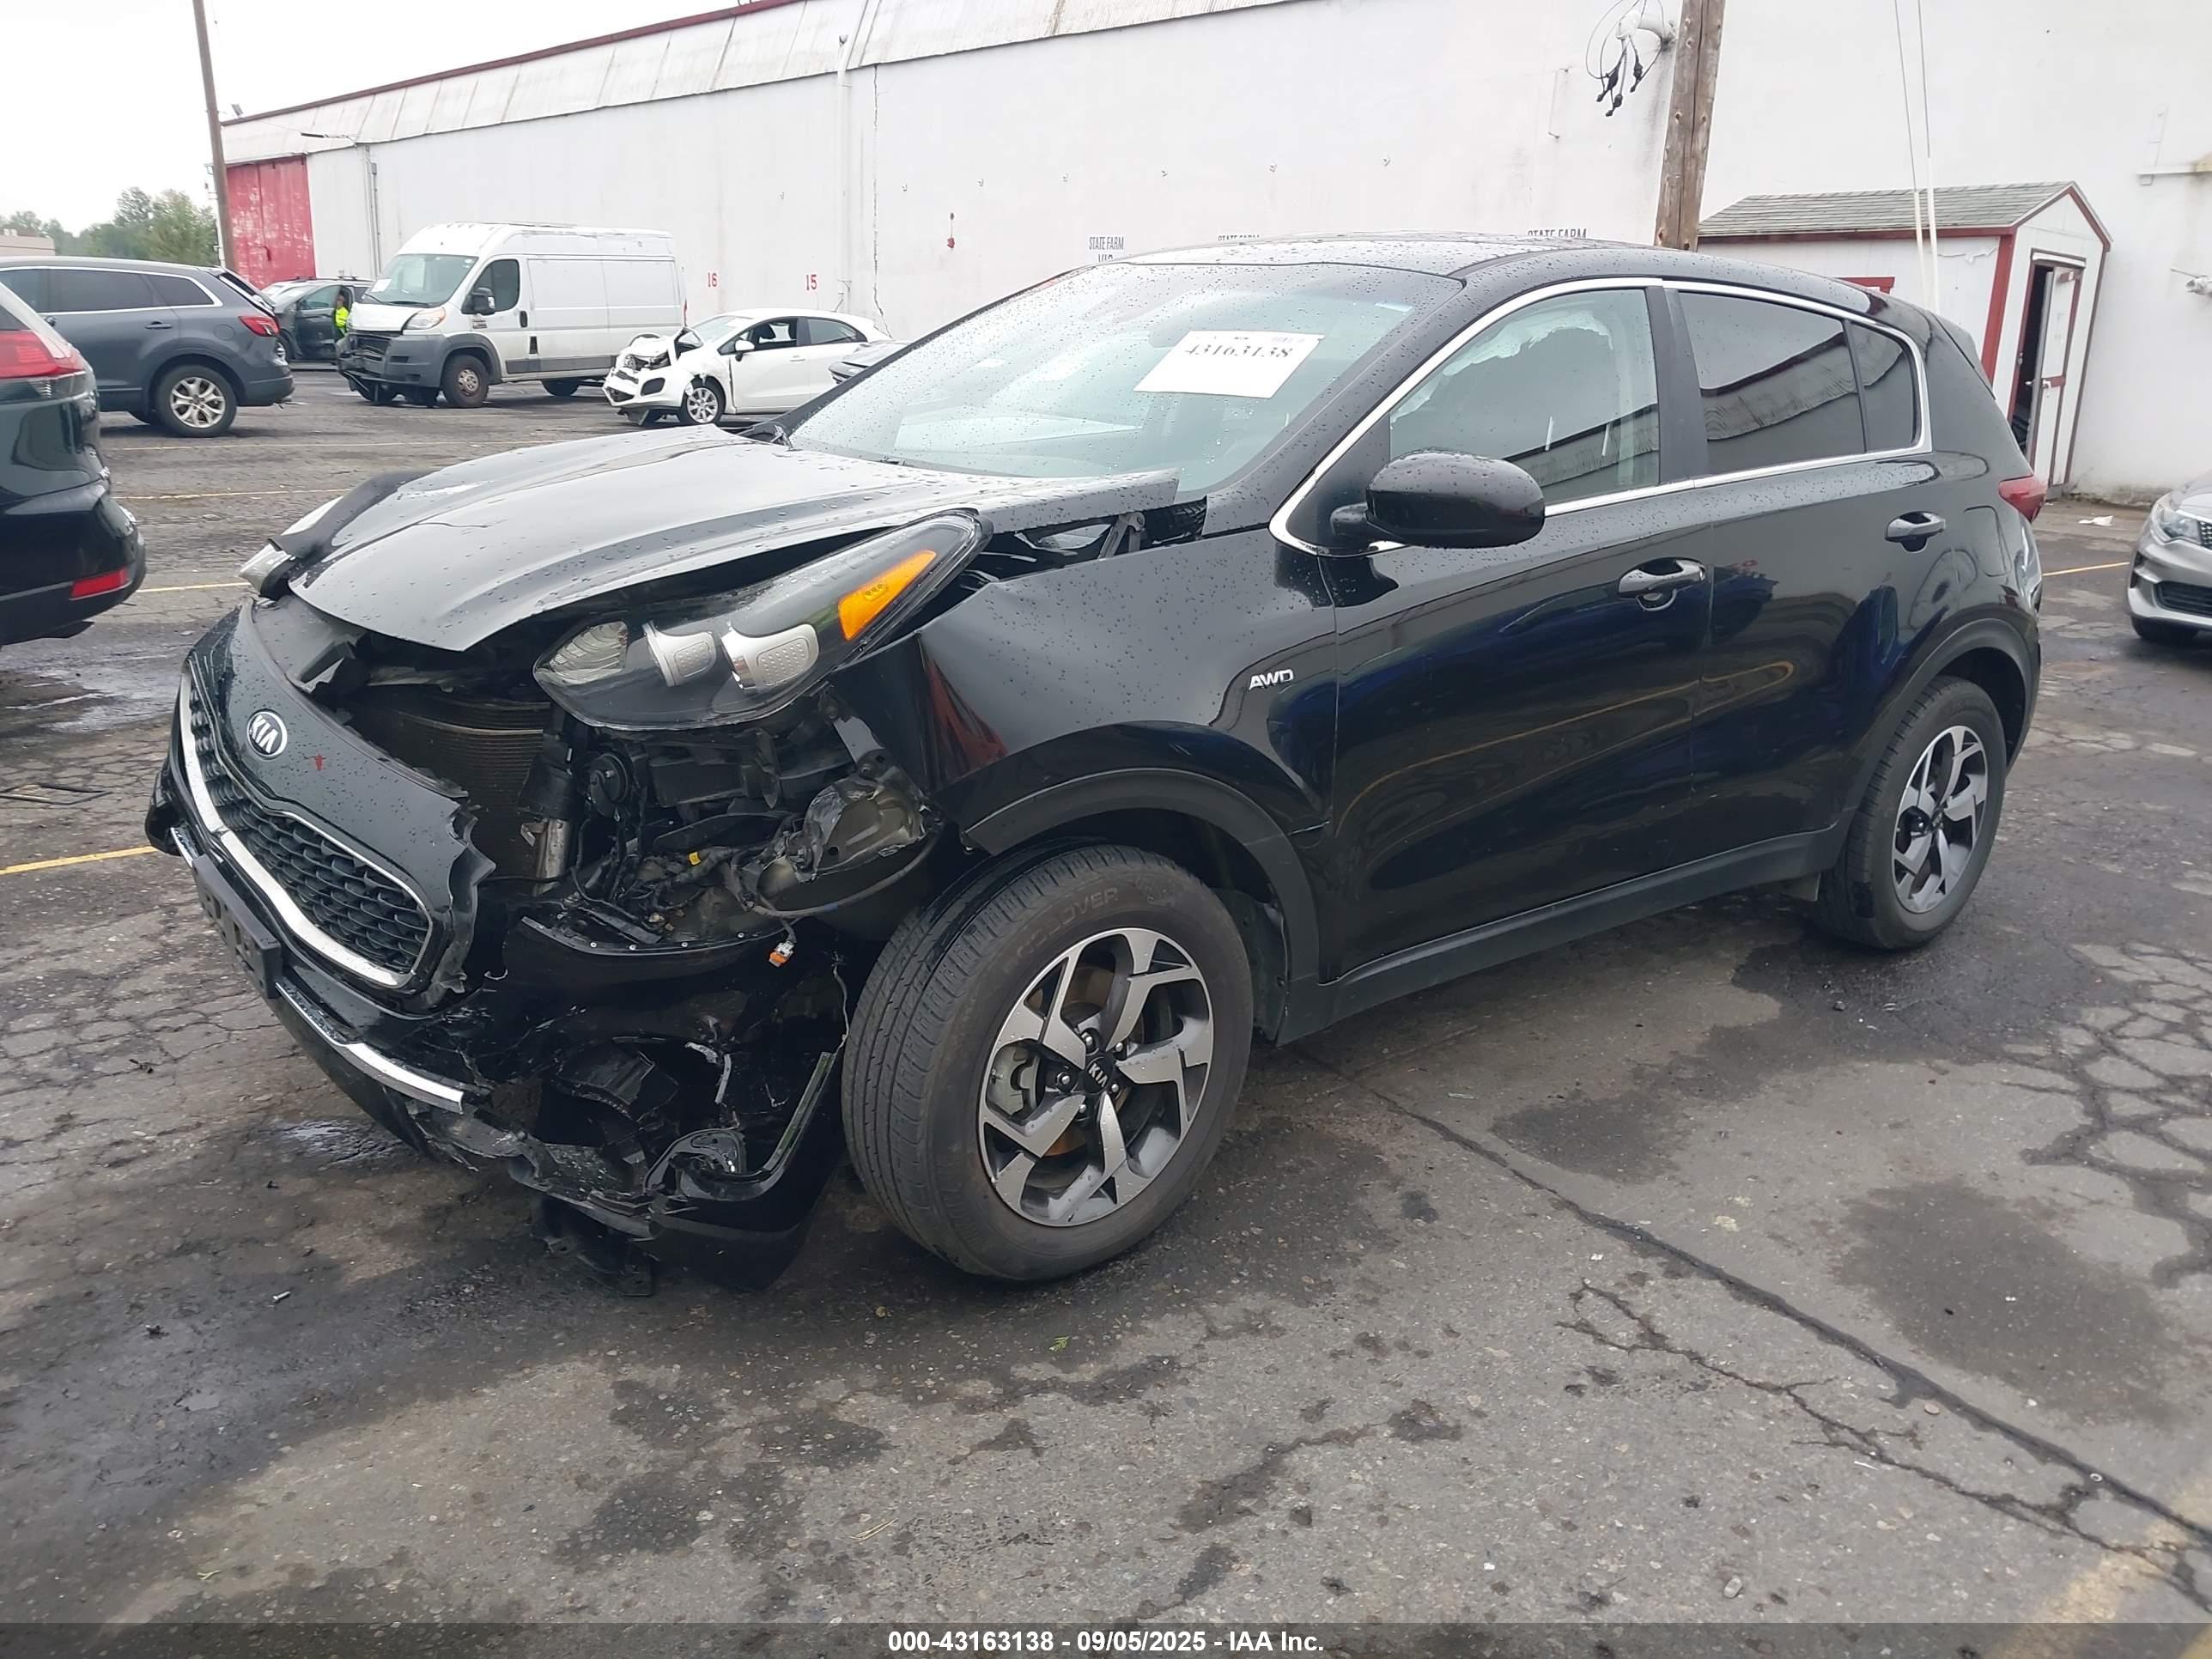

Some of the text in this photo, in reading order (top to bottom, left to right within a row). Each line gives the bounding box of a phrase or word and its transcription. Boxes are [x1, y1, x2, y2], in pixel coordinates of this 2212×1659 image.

[1089, 236, 1124, 250] STATE FARM
[708, 272, 718, 288] 16
[805, 274, 817, 291] 15
[1249, 669, 1294, 691] AWD
[252, 714, 279, 754] KIA
[1088, 1063, 1108, 1087] KIA
